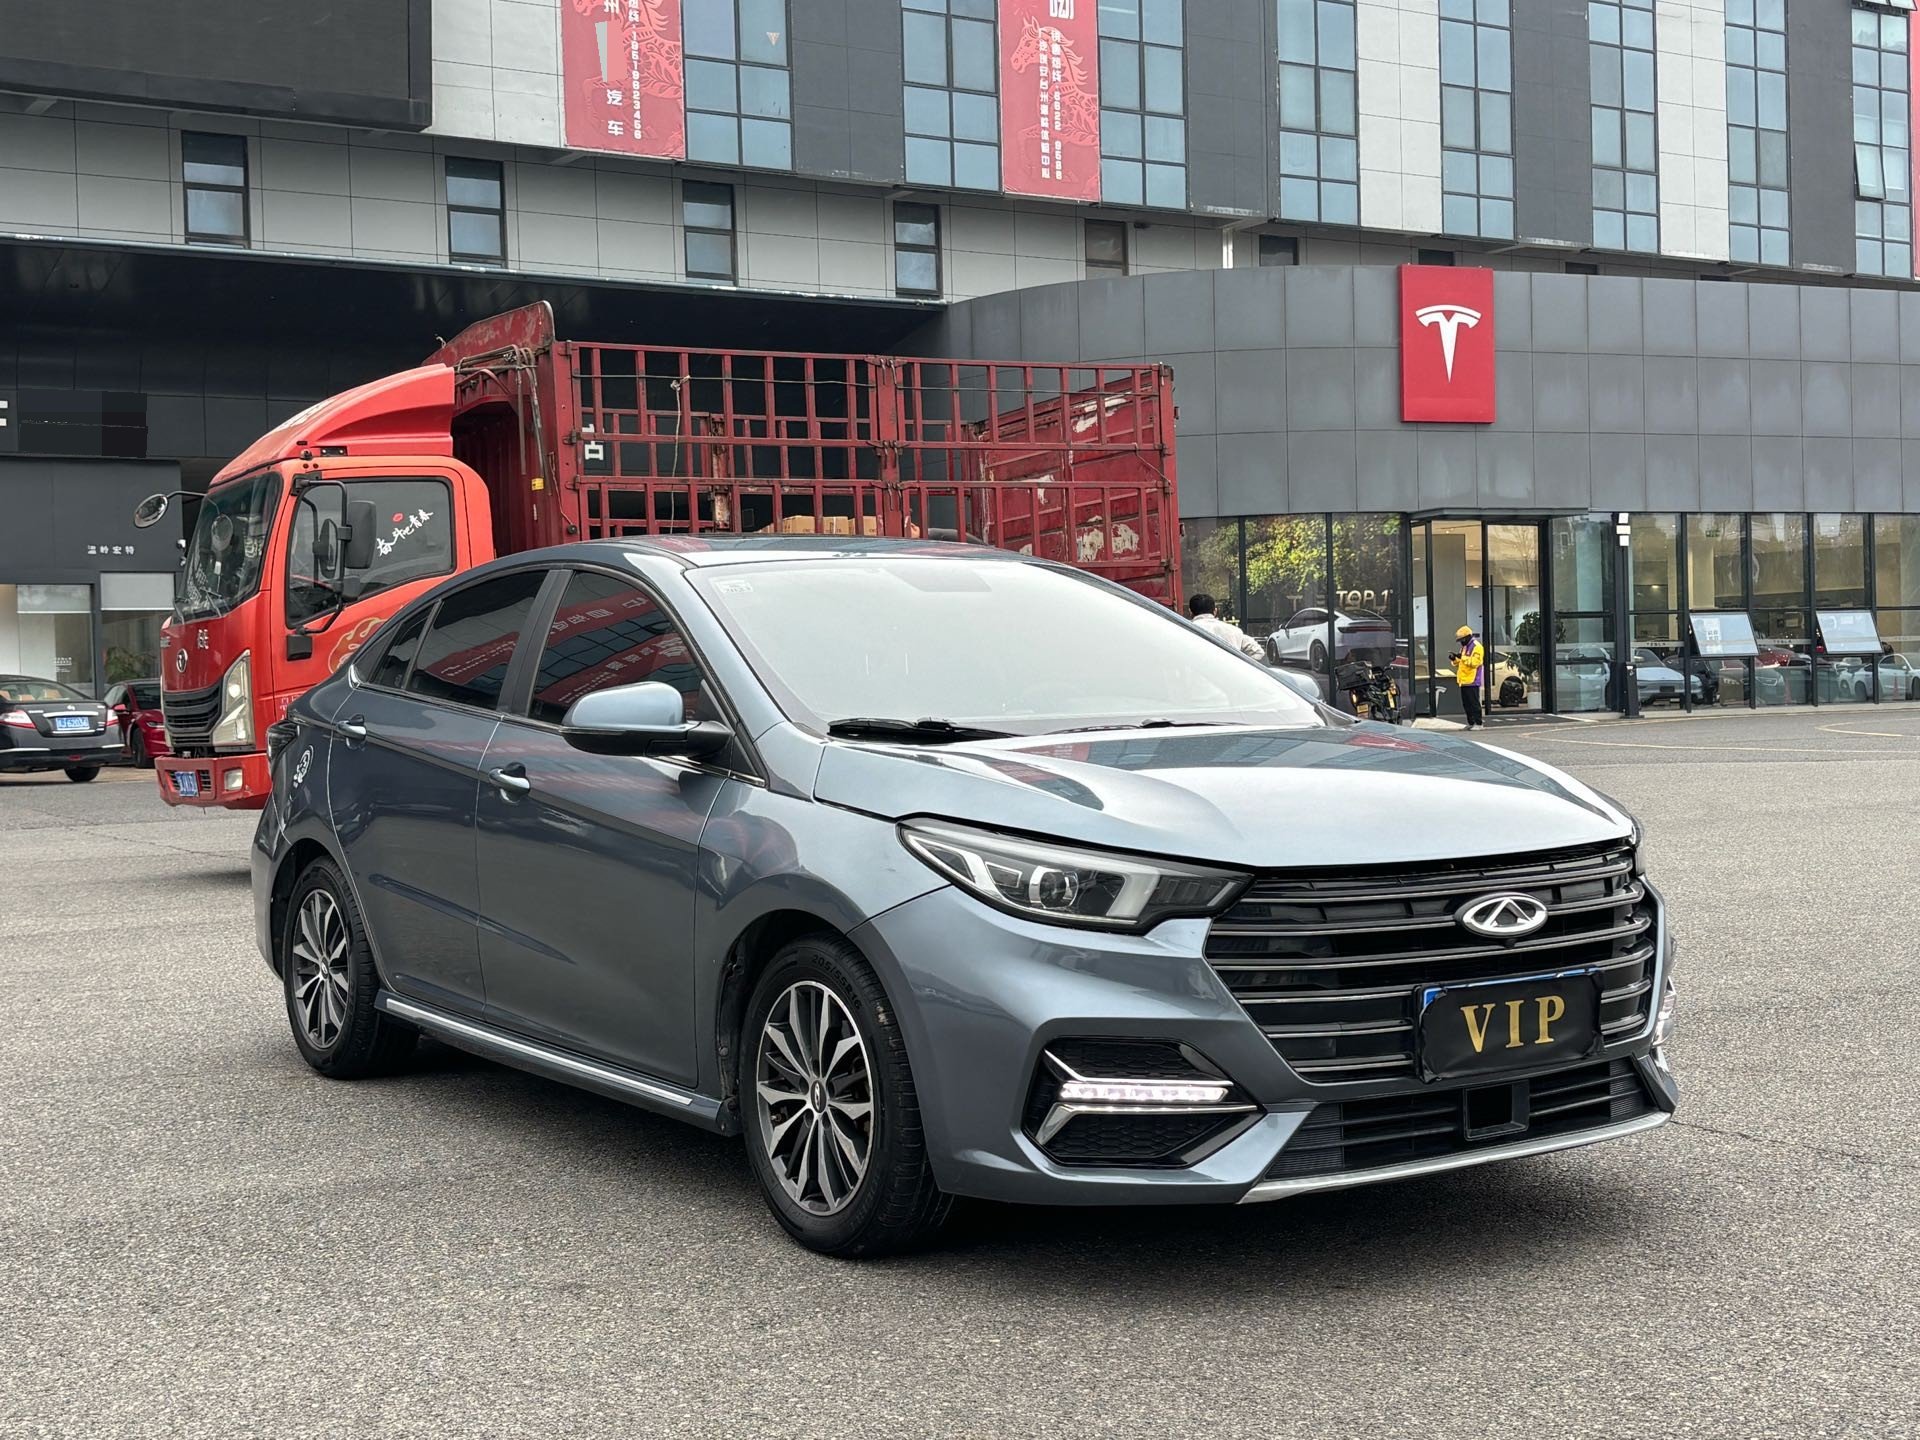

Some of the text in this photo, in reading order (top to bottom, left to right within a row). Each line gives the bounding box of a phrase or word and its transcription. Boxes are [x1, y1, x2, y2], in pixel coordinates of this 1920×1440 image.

[376, 509, 434, 557] 奋斗吧青春
[1336, 589, 1375, 607] TOP
[1460, 995, 1565, 1053] VIP
